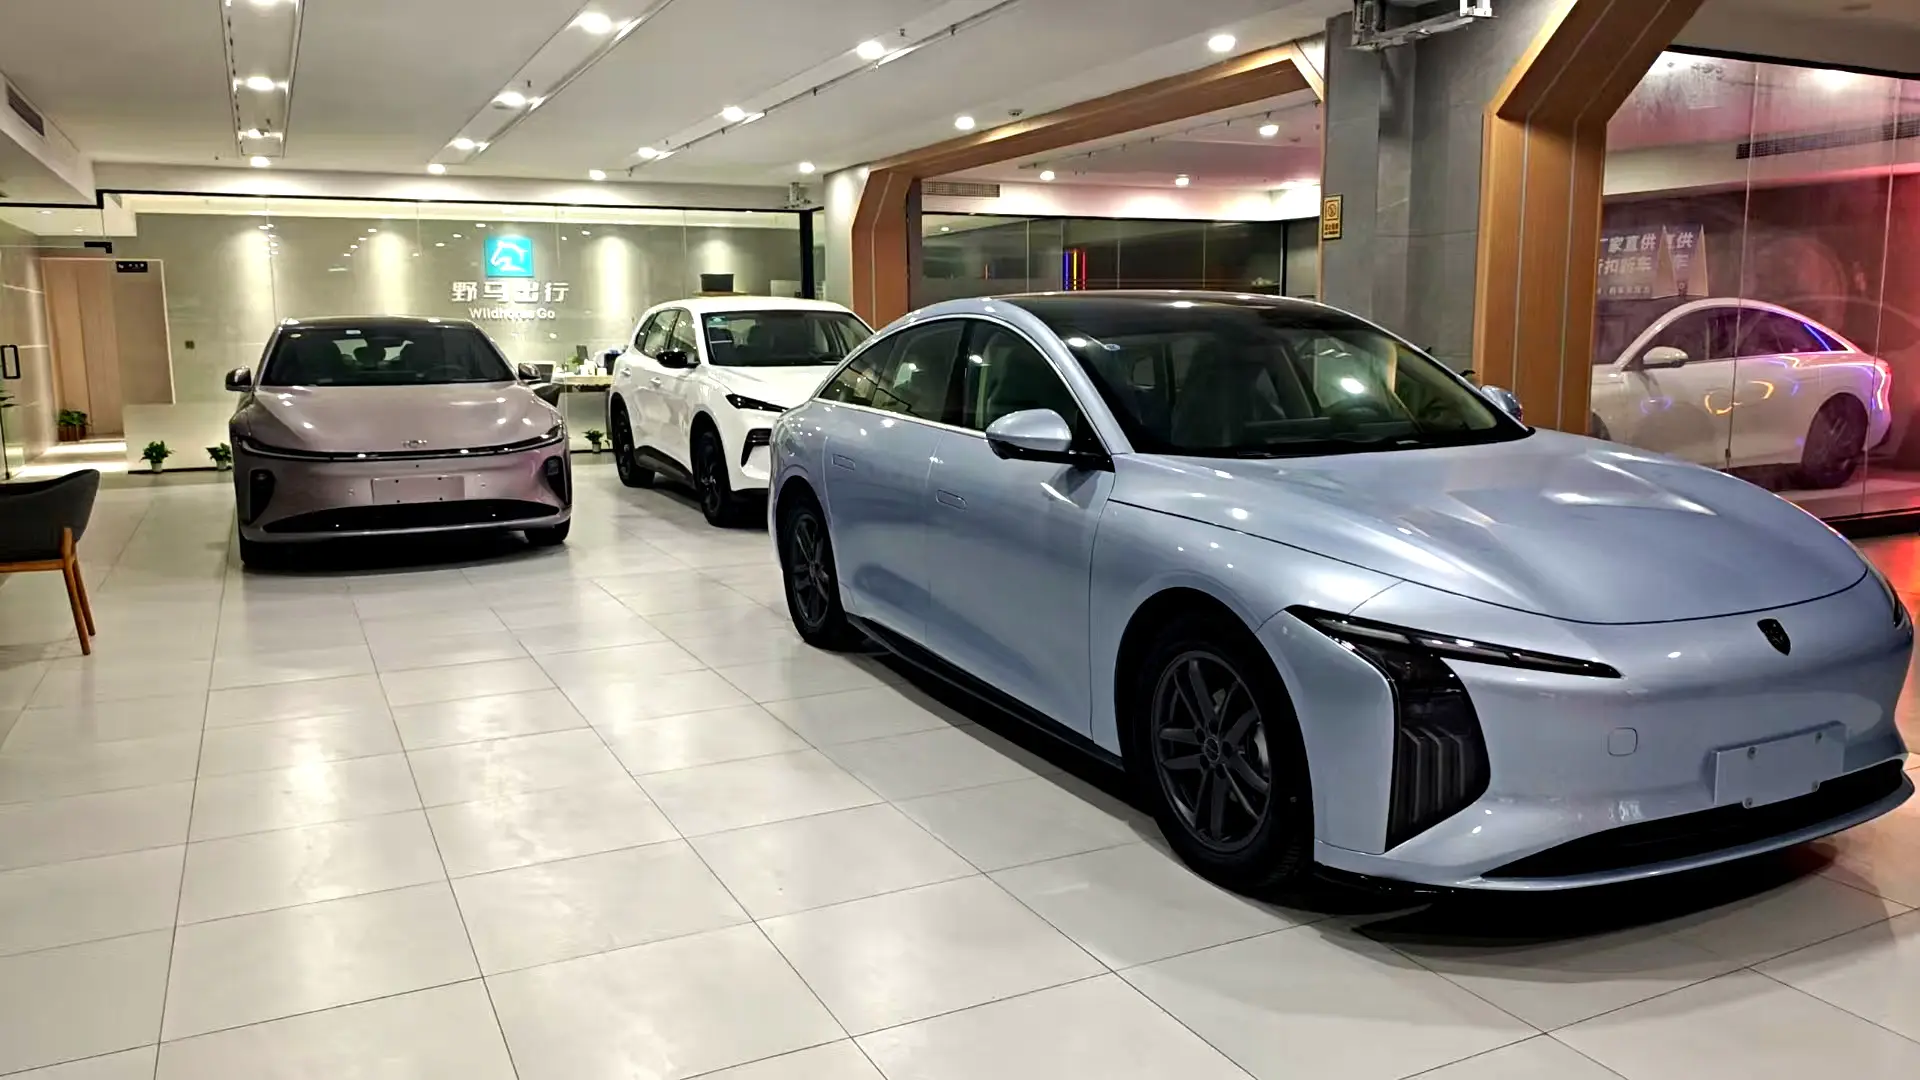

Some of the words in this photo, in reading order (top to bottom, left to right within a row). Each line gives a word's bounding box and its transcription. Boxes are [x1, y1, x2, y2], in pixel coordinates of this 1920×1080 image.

[451, 281, 570, 302] 野马出行
[468, 307, 535, 319] Wildho
[536, 307, 556, 319] Go
